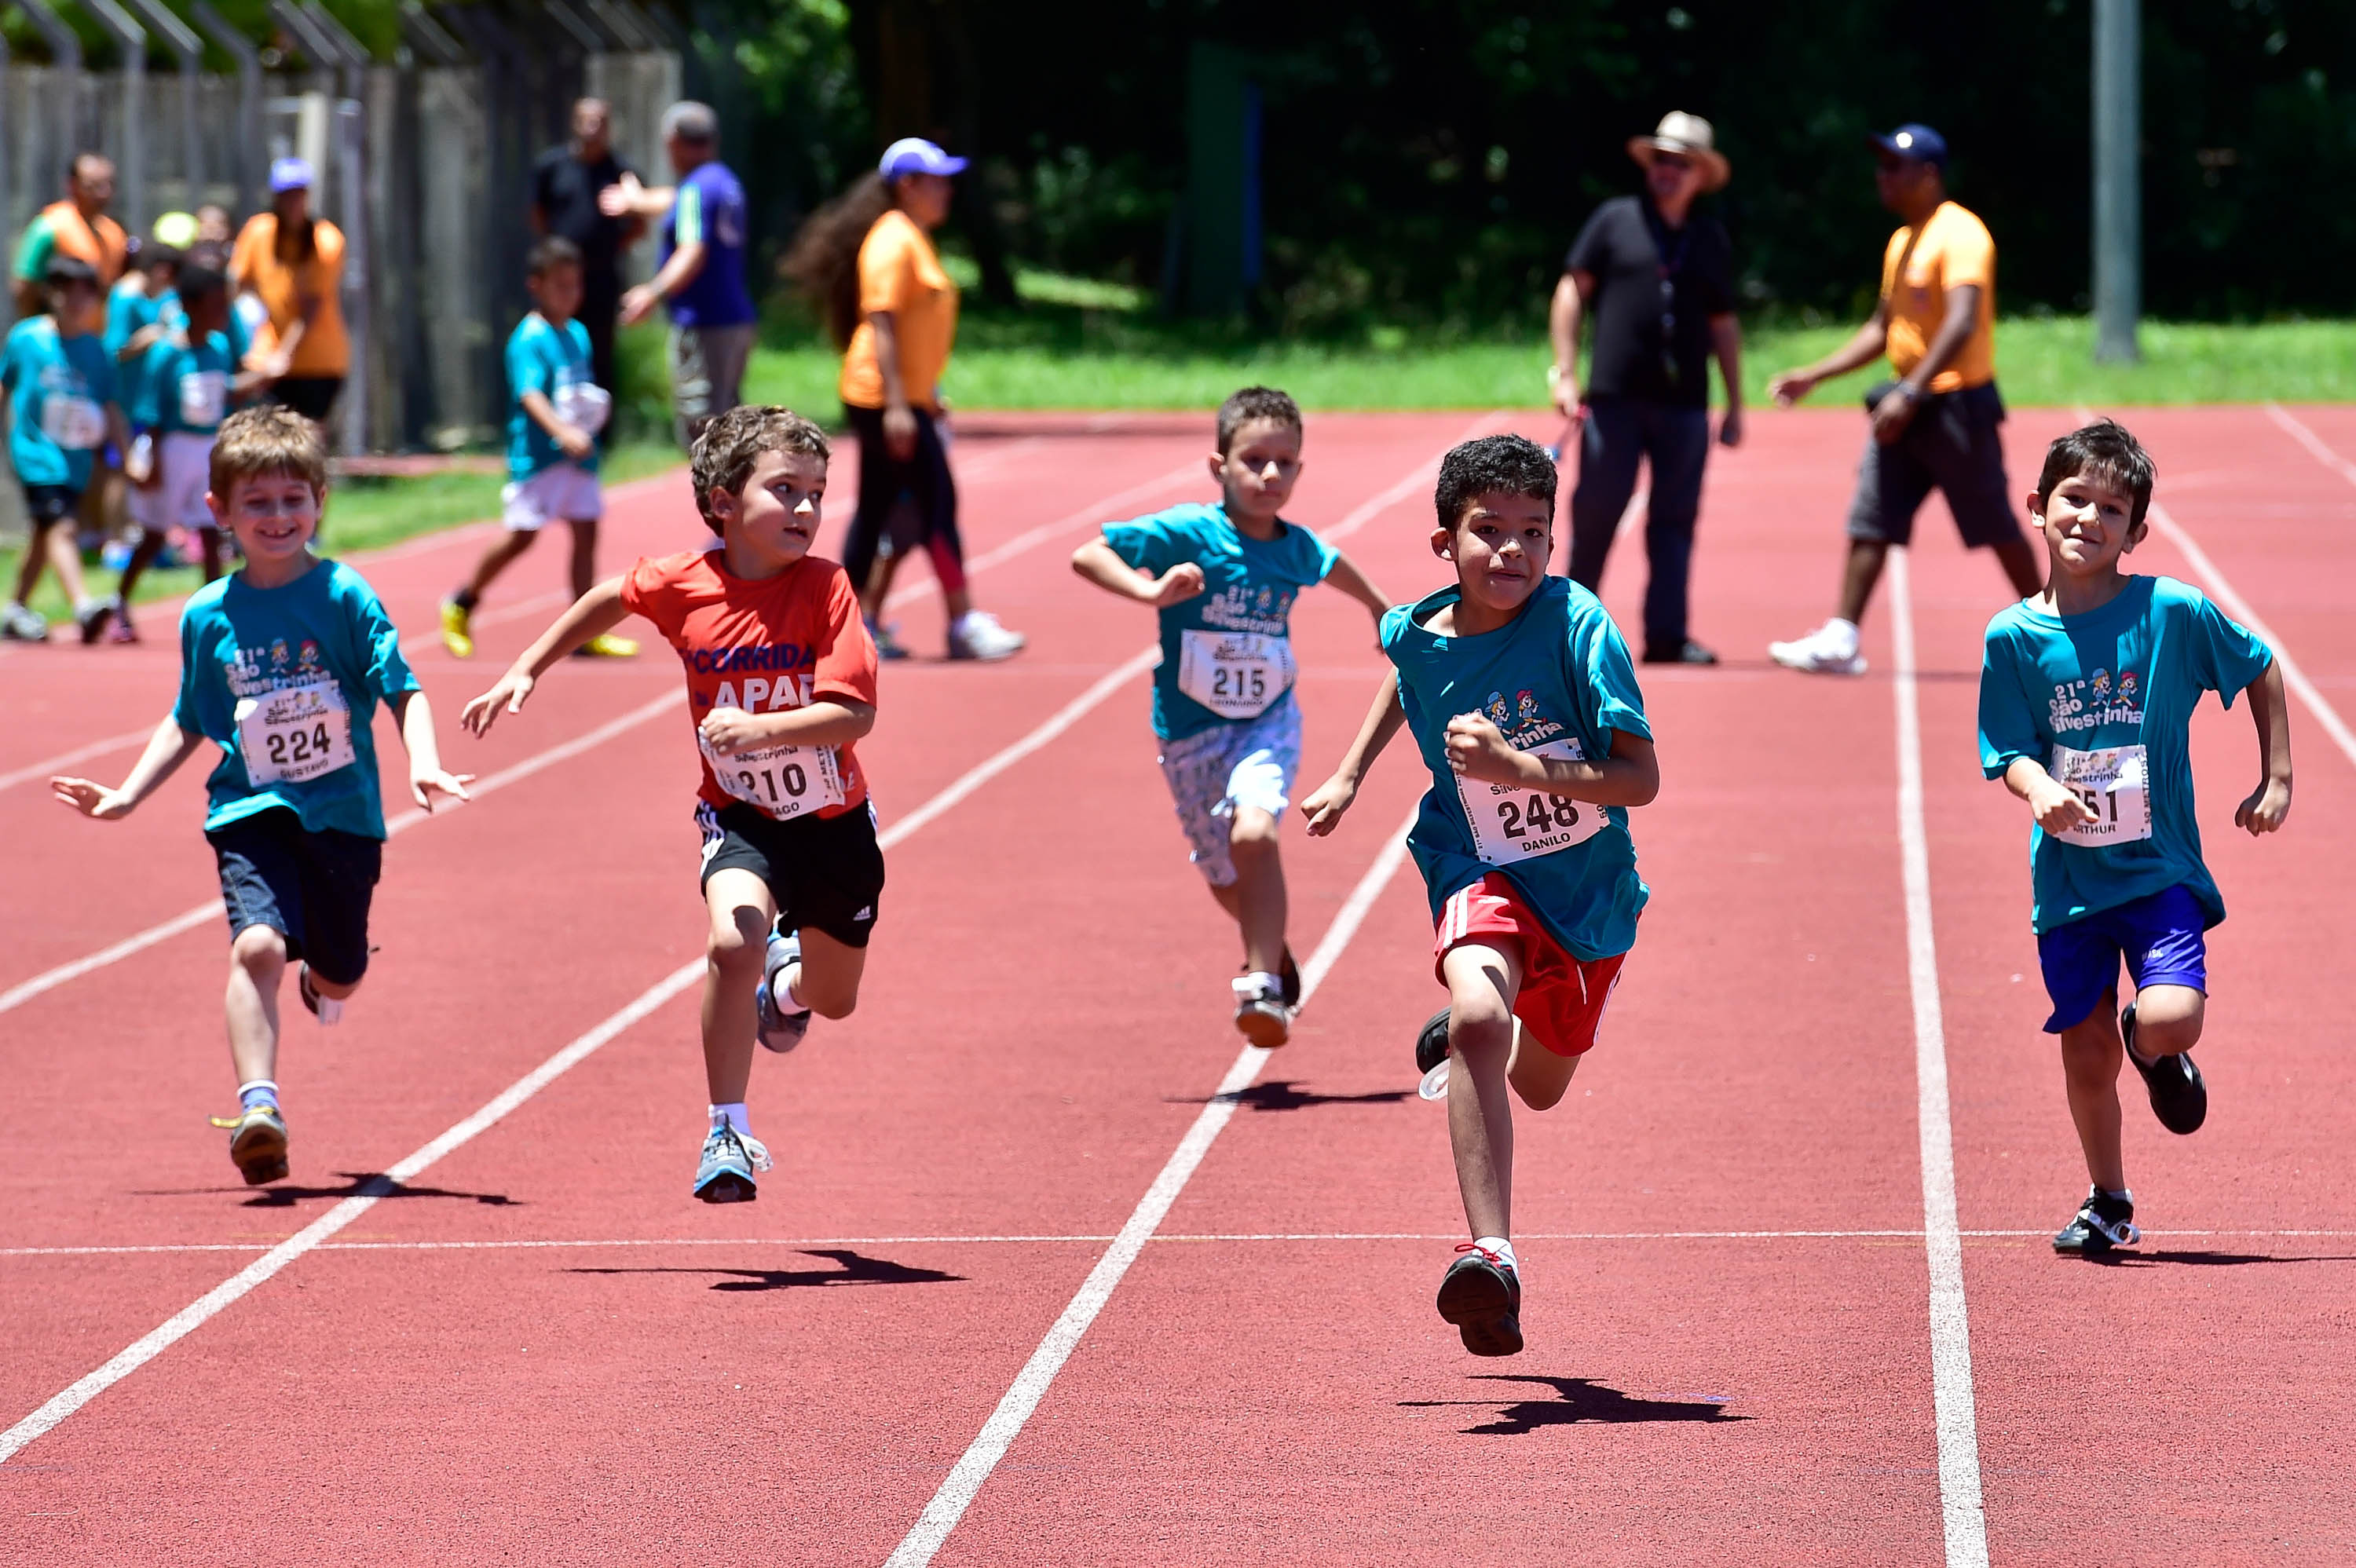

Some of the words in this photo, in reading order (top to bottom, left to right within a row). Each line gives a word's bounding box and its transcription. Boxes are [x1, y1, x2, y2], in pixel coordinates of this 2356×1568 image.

[1213, 669, 1264, 696] 215
[267, 723, 331, 763] 224
[774, 802, 799, 815] AGO
[1498, 794, 1579, 839] 248
[1522, 833, 1571, 852] DANILO
